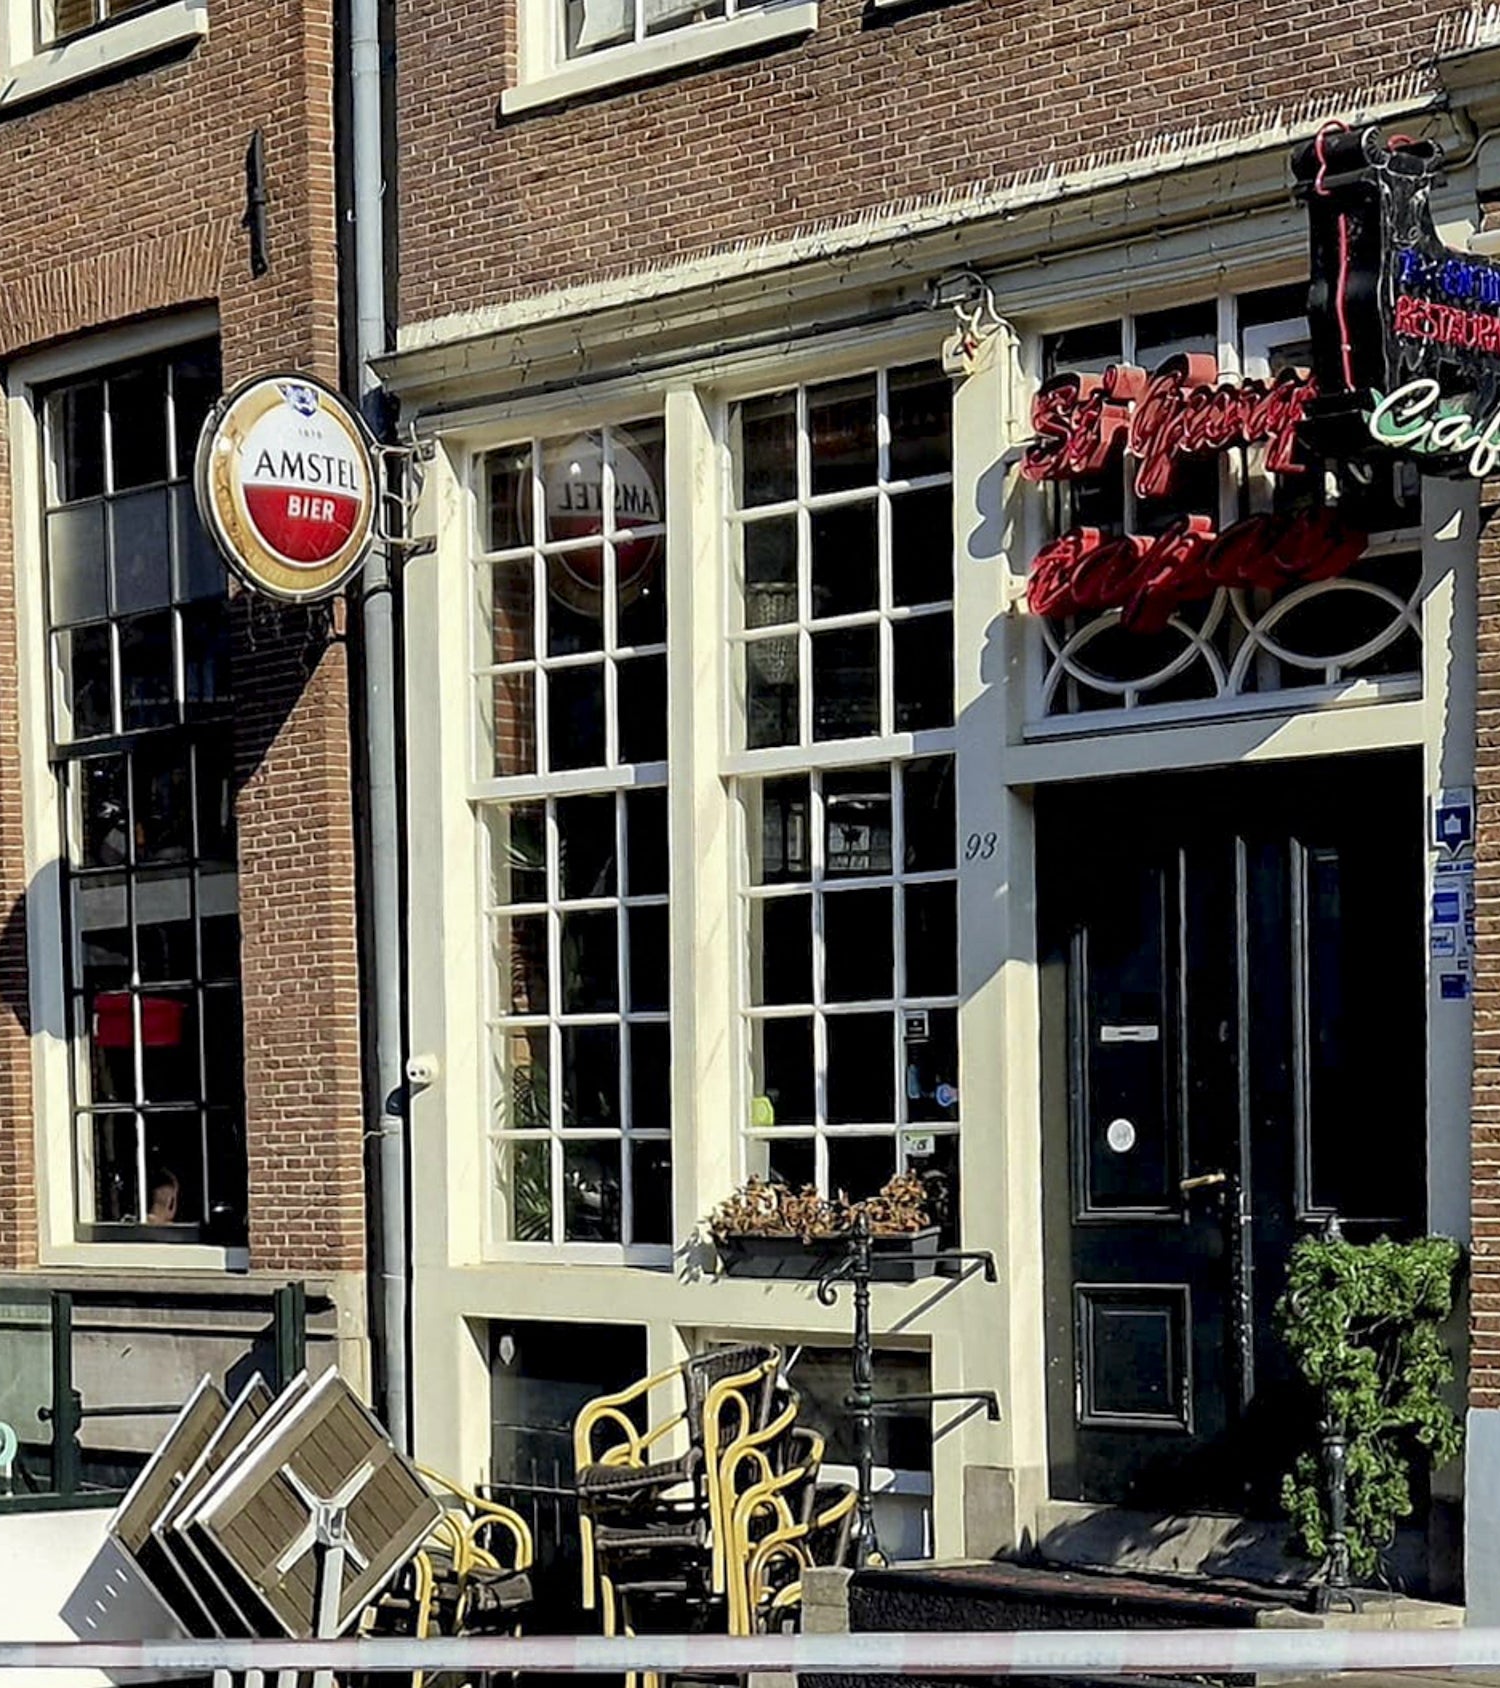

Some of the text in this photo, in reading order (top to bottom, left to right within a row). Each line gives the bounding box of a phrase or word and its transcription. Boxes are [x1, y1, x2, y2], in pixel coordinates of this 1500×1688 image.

[253, 449, 358, 491] AMSTEL
[287, 494, 336, 523] BIER
[965, 832, 998, 861] 93
